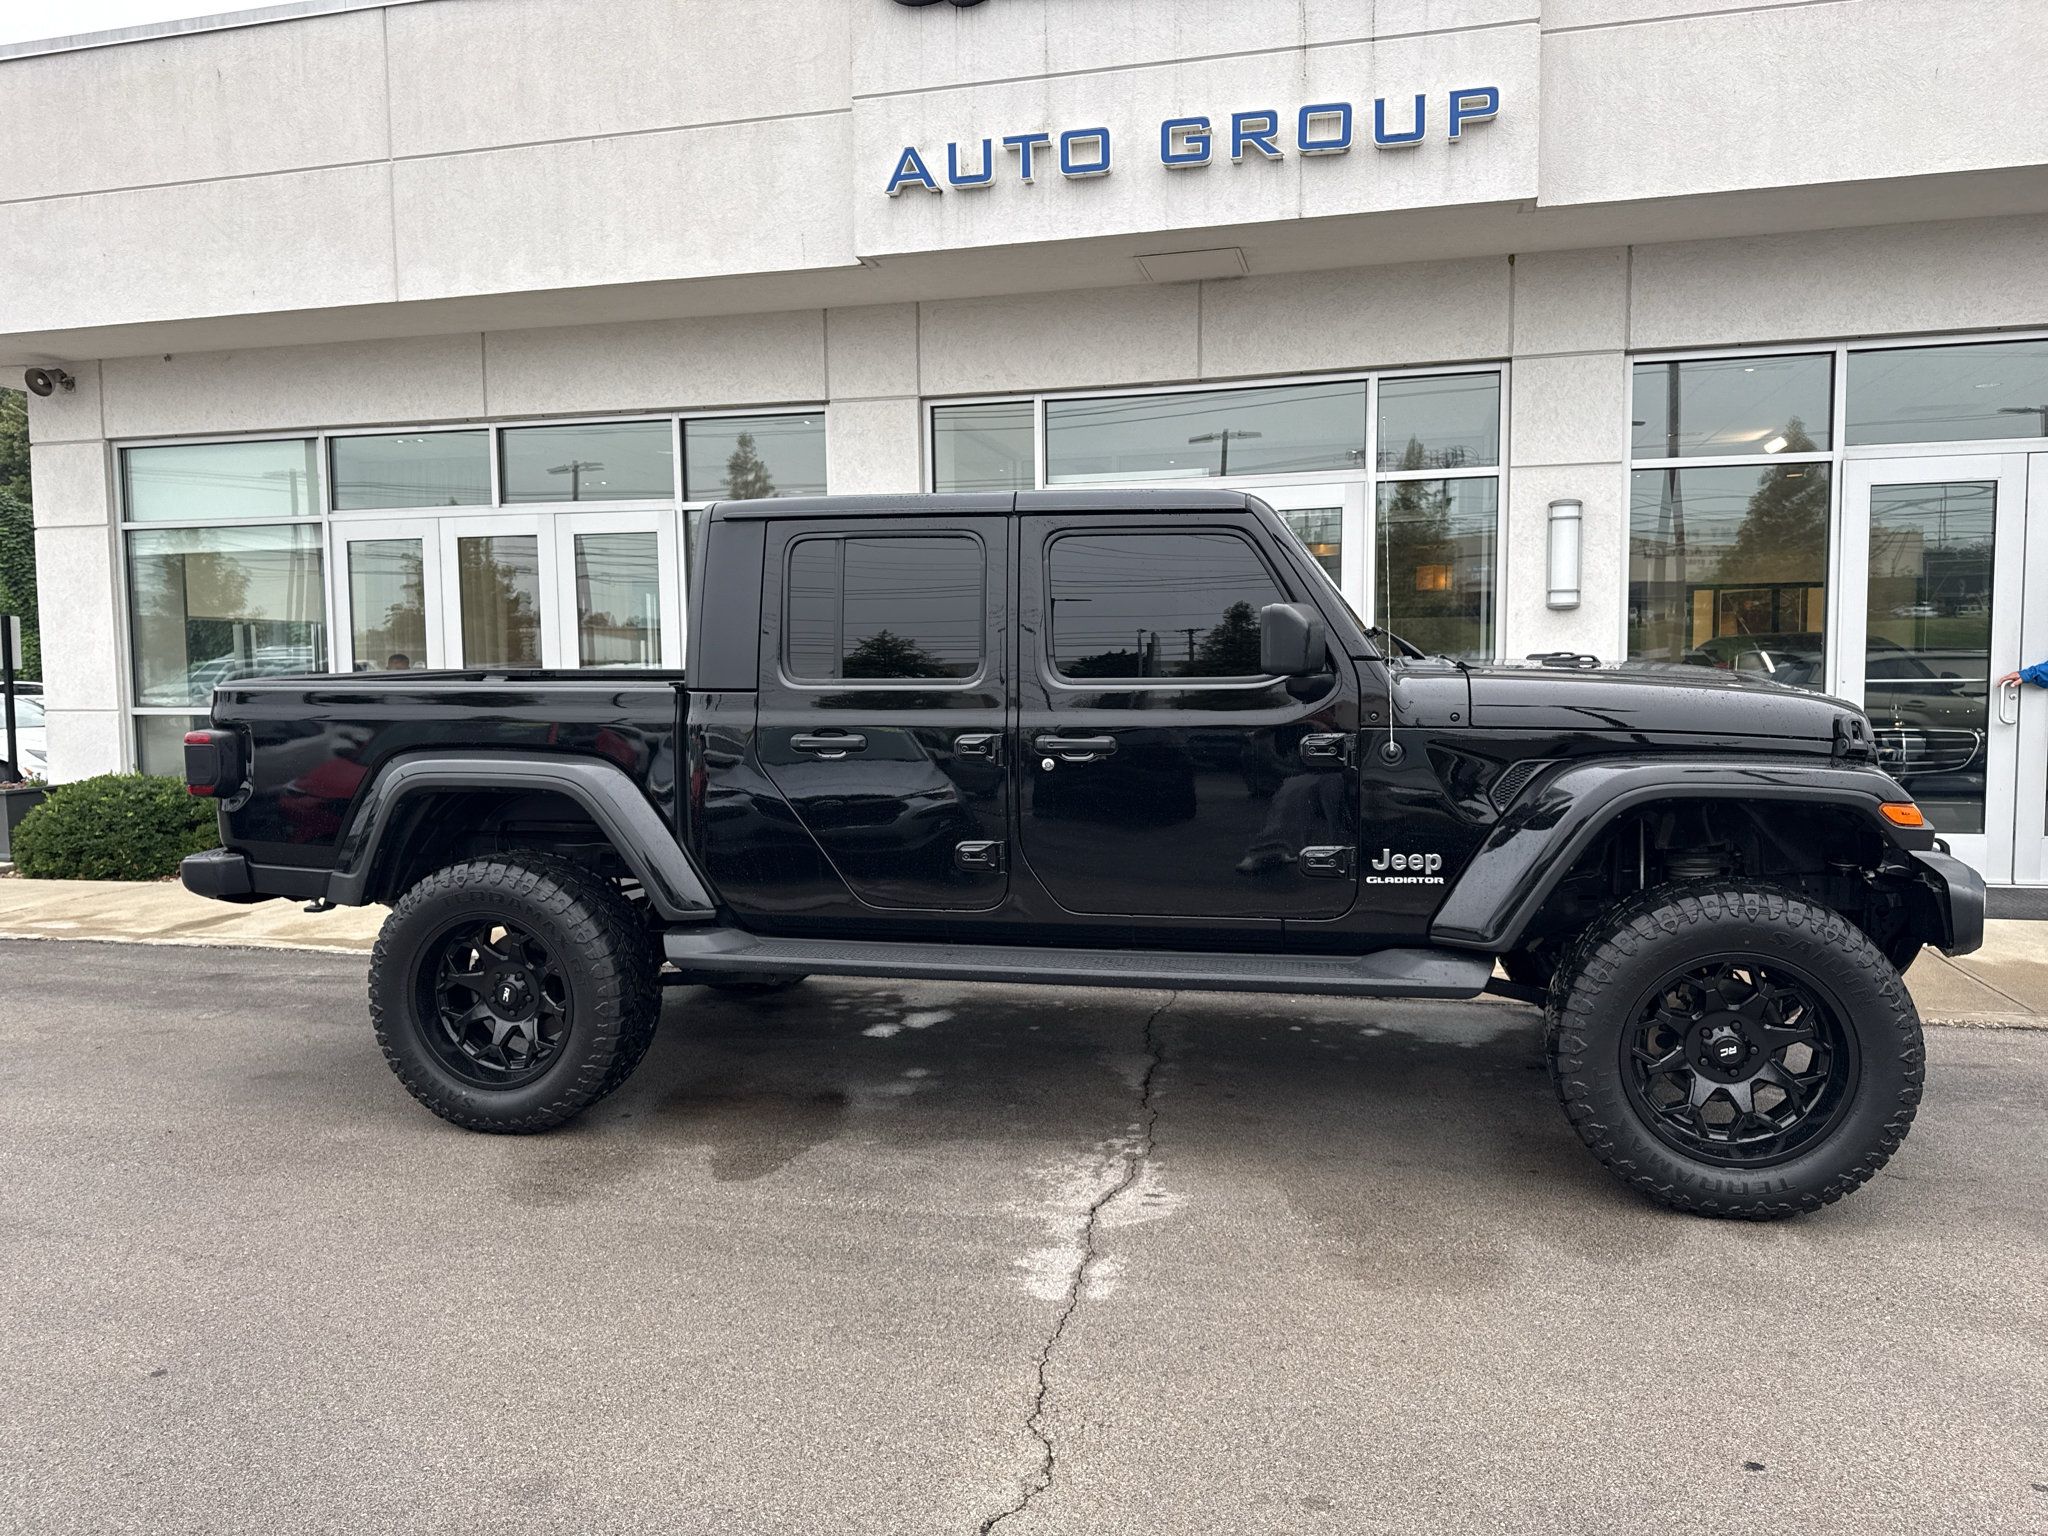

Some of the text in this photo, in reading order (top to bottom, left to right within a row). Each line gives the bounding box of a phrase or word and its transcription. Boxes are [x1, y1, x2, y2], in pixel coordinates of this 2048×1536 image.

[885, 86, 1501, 196] AUTO GROUP
[1371, 848, 1442, 875] Jeep
[1366, 876, 1444, 885] GLADIATOR
[1720, 1045, 1737, 1057] RC
